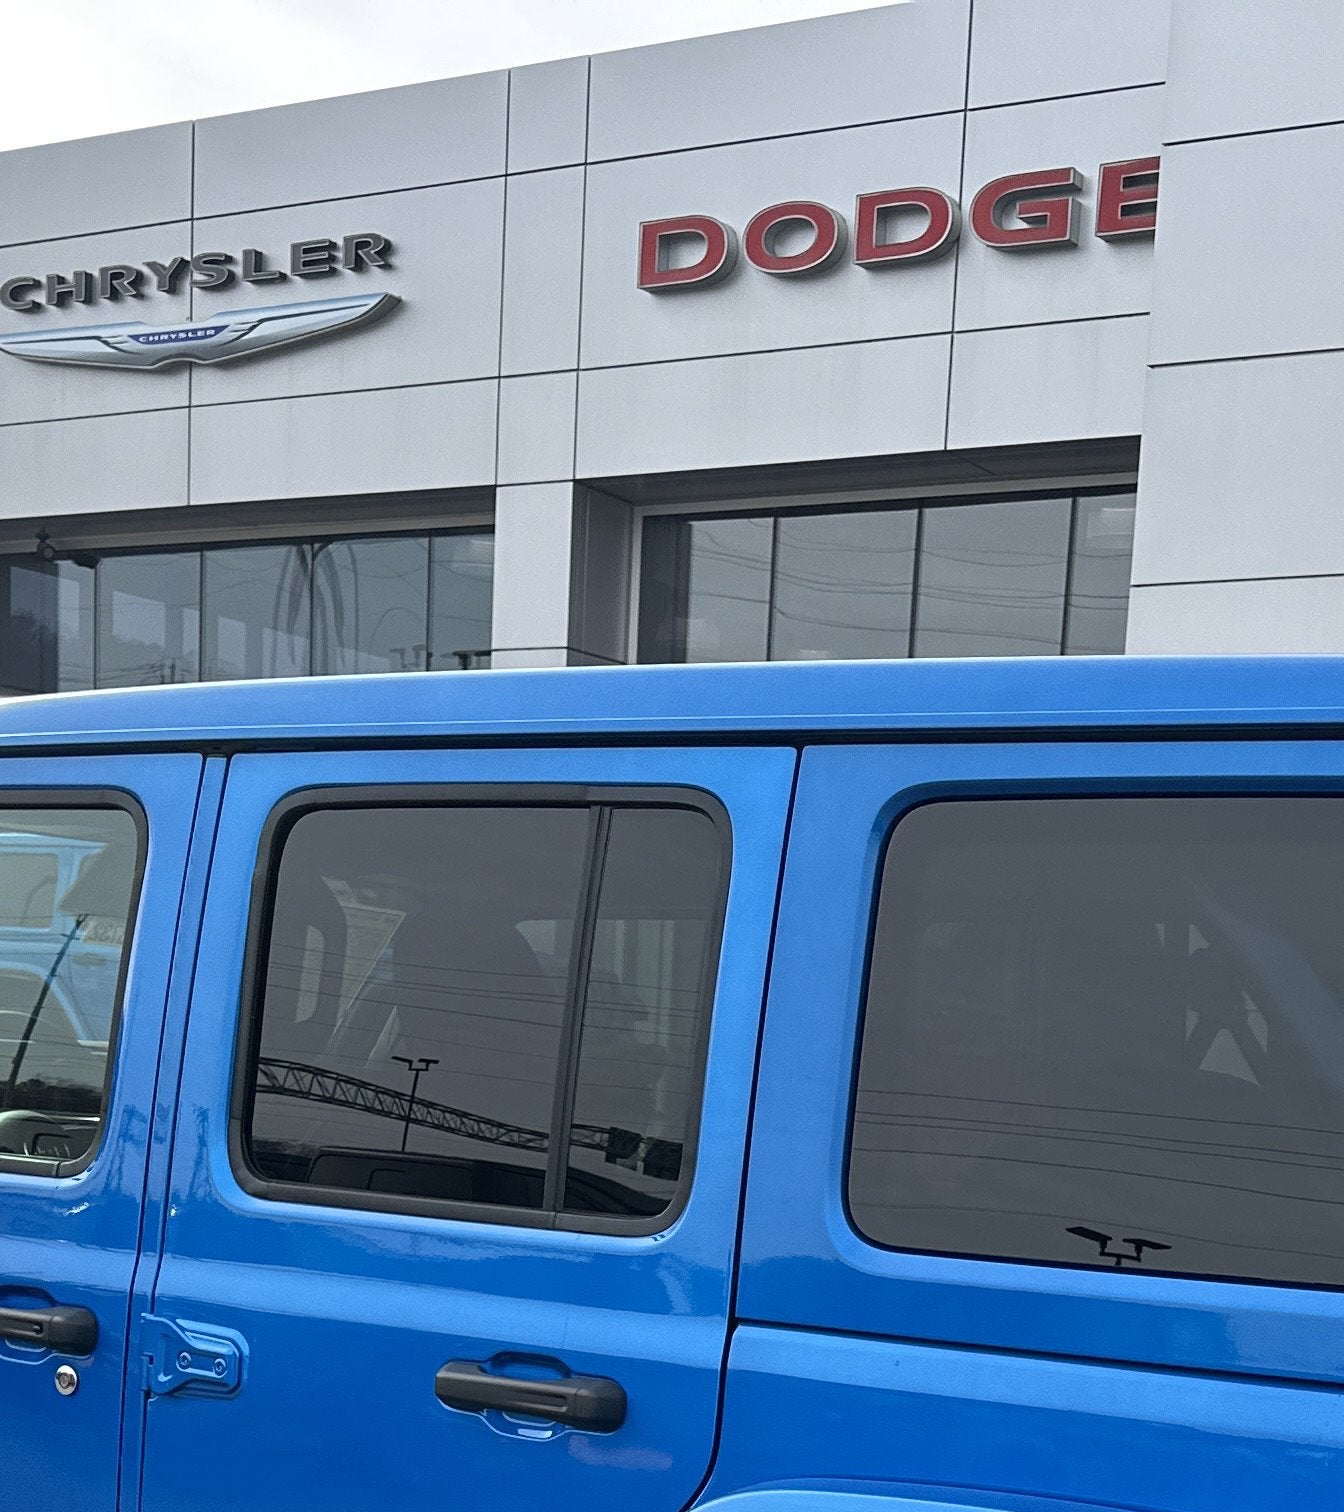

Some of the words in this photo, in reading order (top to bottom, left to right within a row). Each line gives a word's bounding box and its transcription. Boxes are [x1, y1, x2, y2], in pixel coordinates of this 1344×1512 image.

[637, 156, 1161, 293] DODGE
[0, 232, 392, 312] CHRYSLER
[138, 328, 216, 343] CHRYSLER
